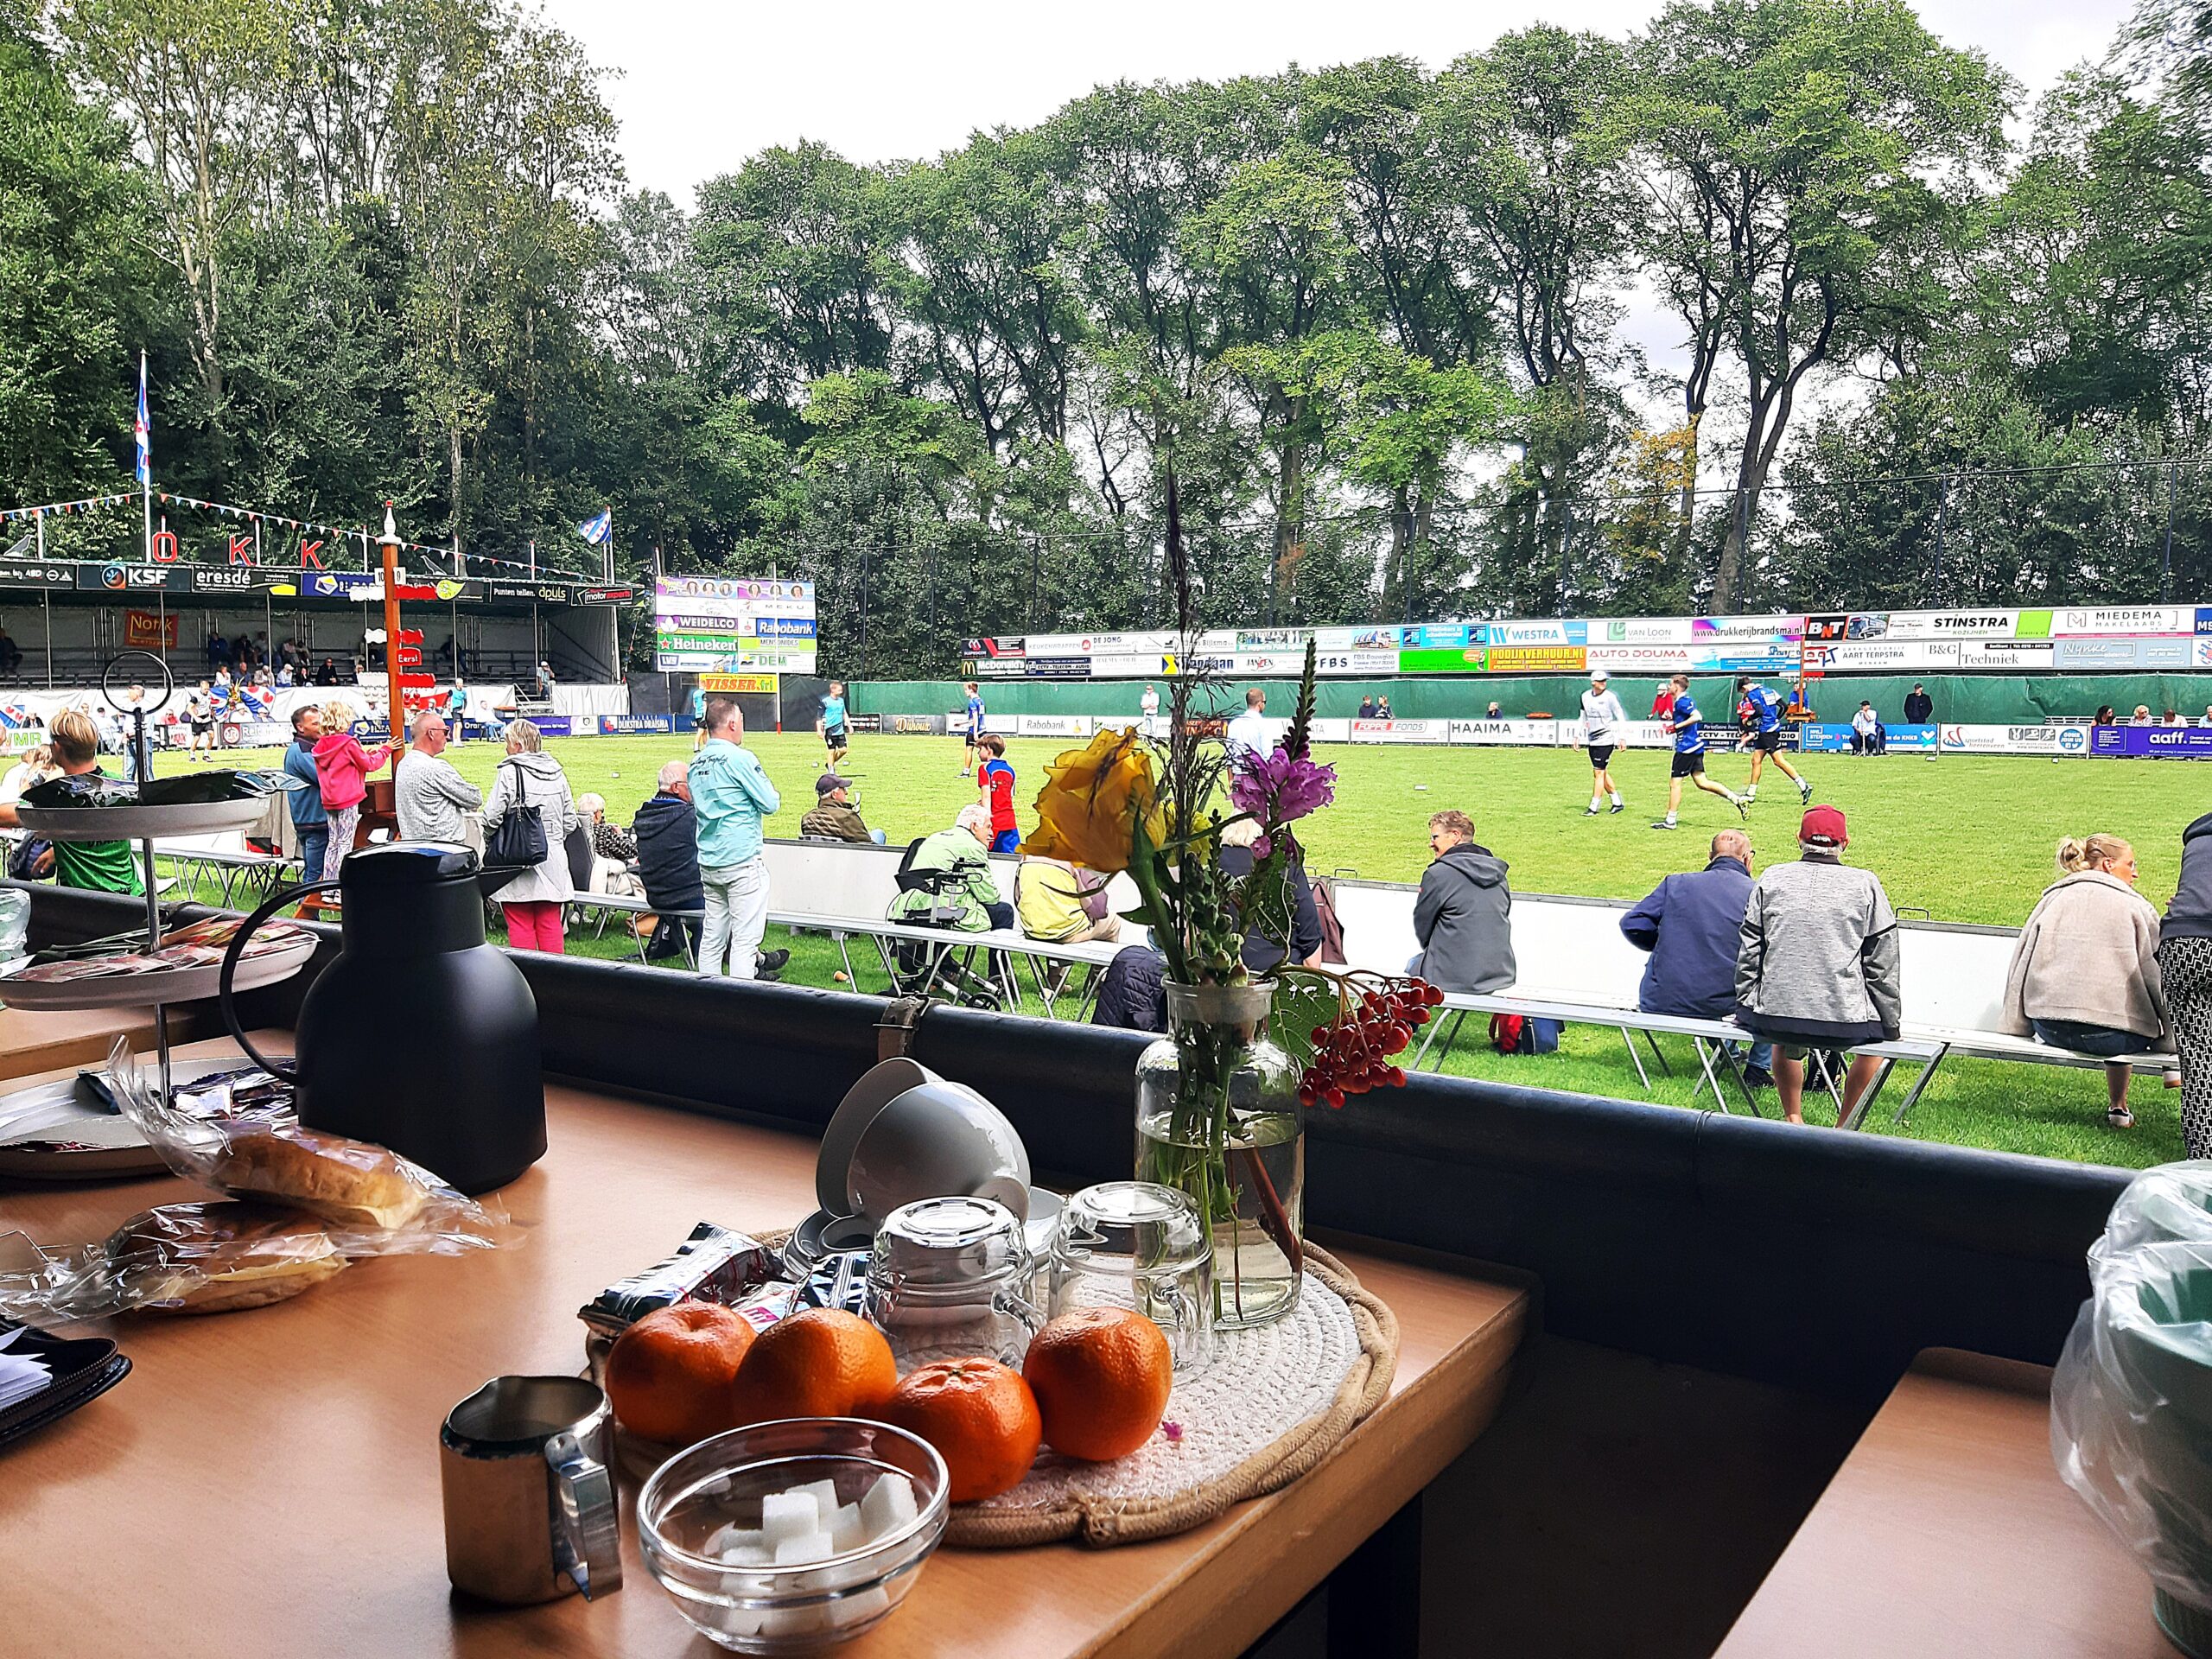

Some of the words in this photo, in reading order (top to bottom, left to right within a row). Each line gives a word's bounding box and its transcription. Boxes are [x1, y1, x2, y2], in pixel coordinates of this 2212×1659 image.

[128, 569, 168, 585] KSF
[196, 569, 251, 584] eresdé
[679, 616, 735, 628] WEIDELCO
[1934, 615, 2008, 627] STINSTRA
[1512, 630, 1559, 639] WESTRA
[1694, 626, 1802, 638] www.drukkerijbrandsma.nl
[673, 638, 737, 652] Heineken
[1929, 645, 1956, 655] B&G
[759, 656, 787, 666] DEM
[1962, 653, 2019, 664] Techniek
[1027, 720, 1065, 729] Rabobank
[1452, 723, 1512, 734] HAAIMA
[2149, 731, 2187, 744] aaff.
